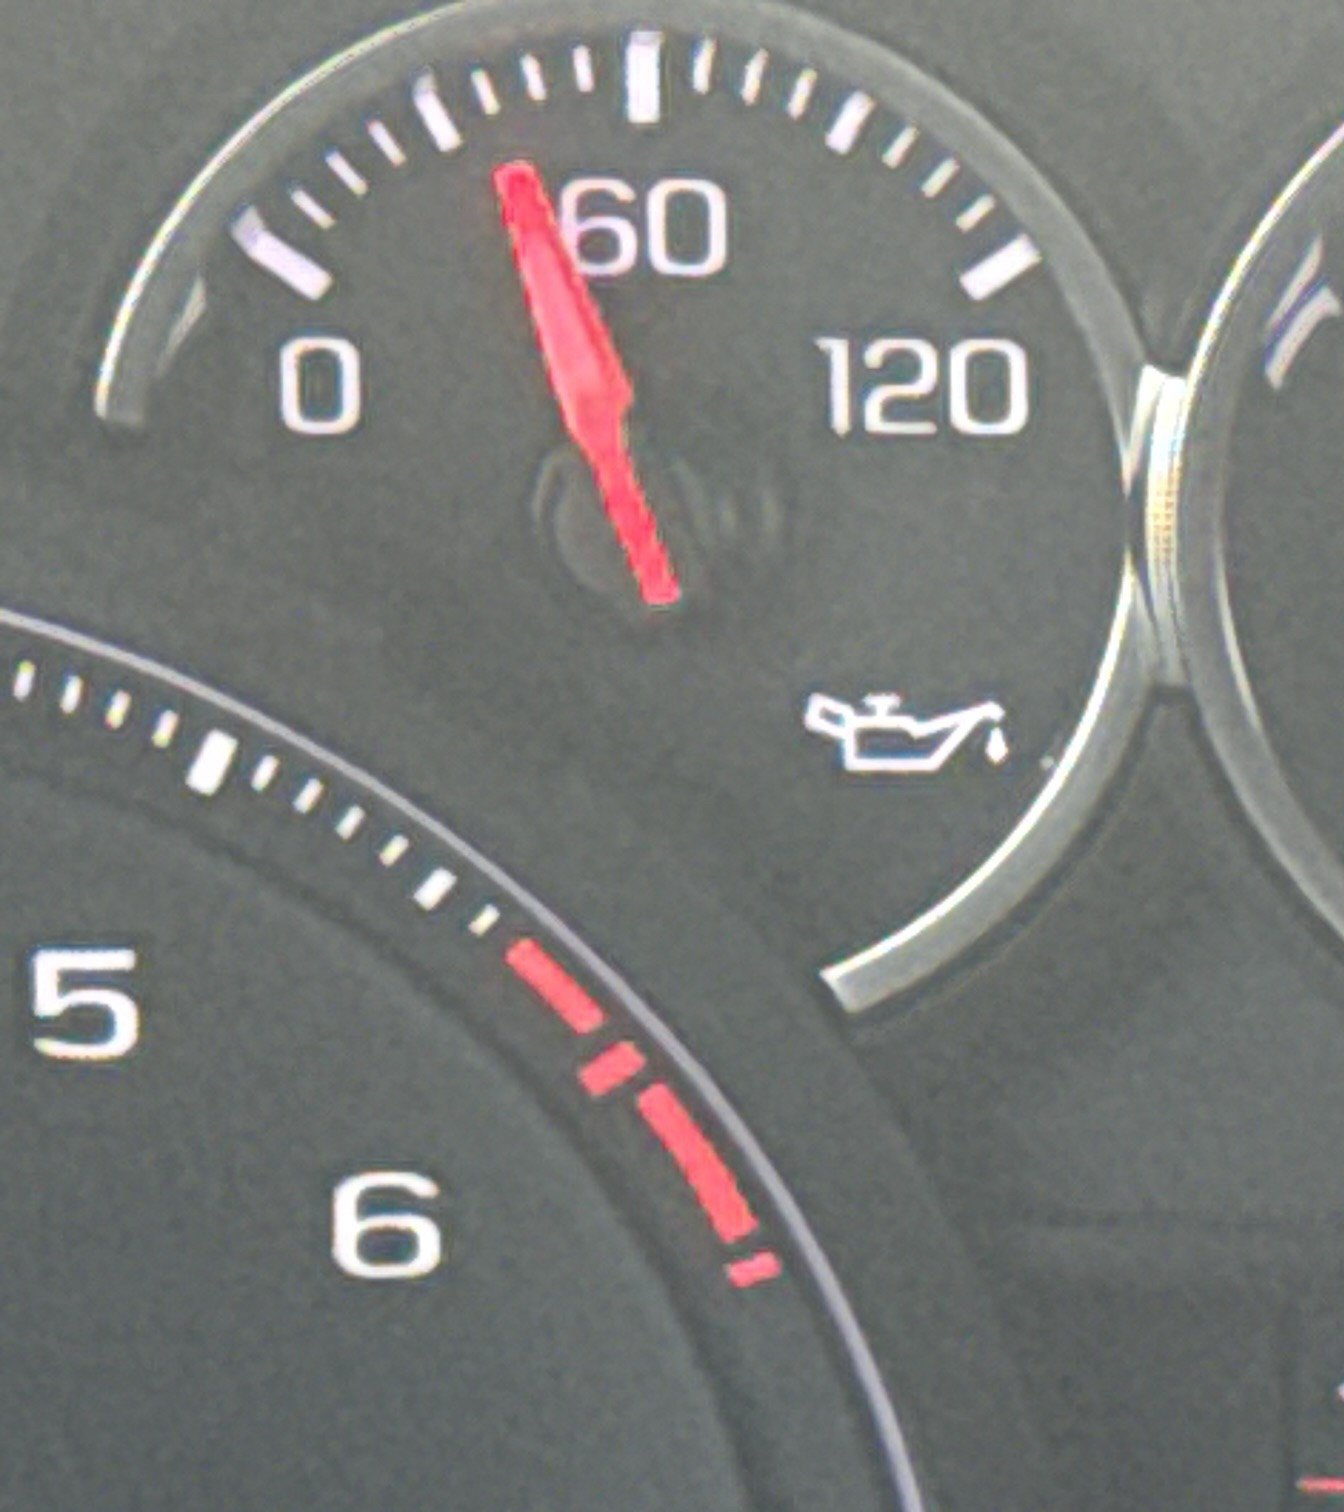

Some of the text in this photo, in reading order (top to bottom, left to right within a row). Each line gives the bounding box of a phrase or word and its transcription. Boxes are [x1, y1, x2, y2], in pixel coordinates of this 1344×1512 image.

[562, 177, 728, 278] 60
[279, 335, 362, 436] 0
[815, 336, 1030, 436] 120
[31, 947, 140, 1061] 5
[331, 1170, 442, 1280] 6
